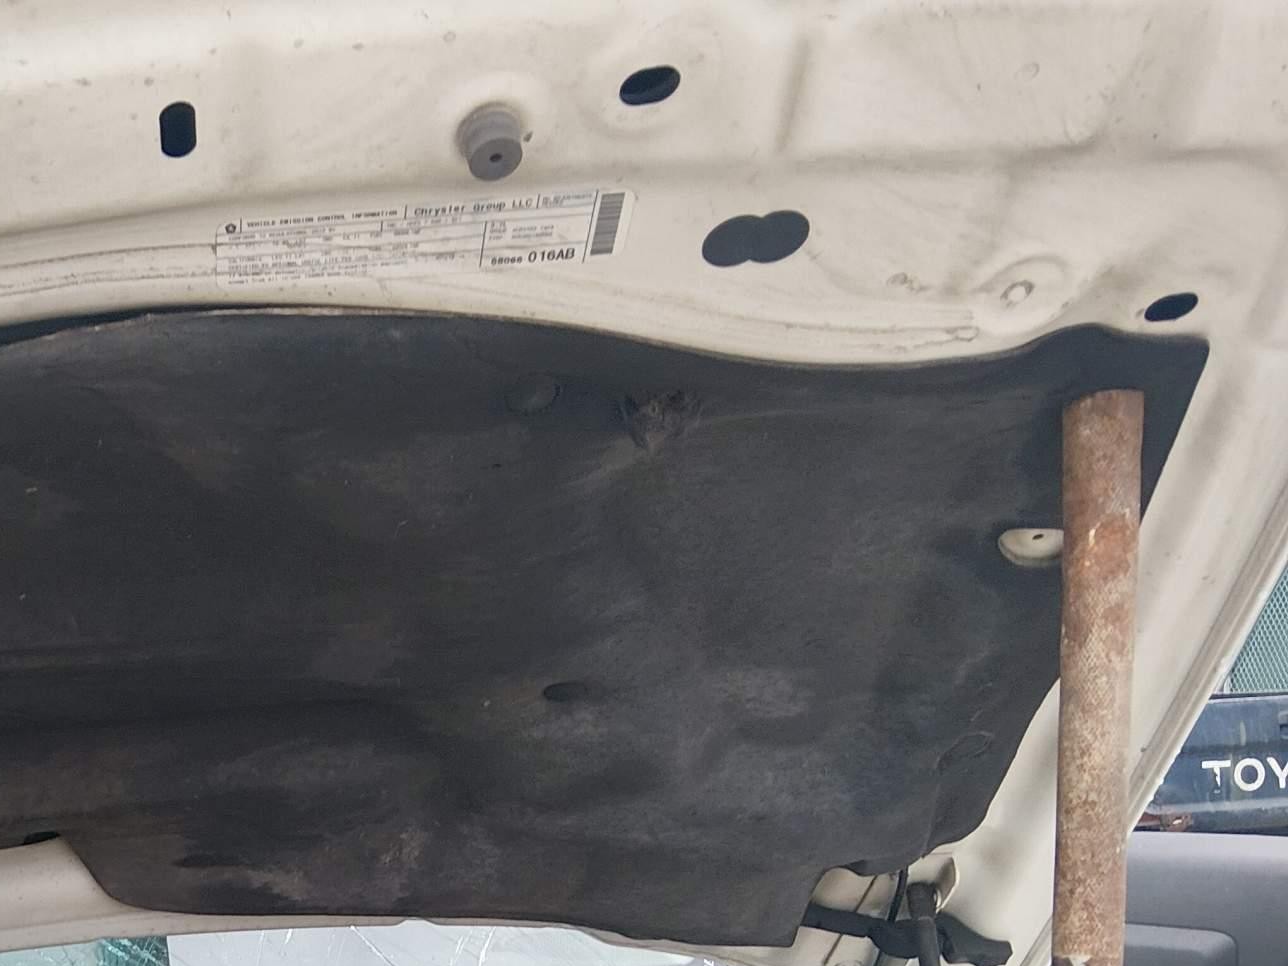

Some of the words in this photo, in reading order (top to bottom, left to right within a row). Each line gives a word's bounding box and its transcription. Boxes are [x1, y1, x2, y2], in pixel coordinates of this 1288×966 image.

[414, 205, 465, 217] Chrysler
[473, 202, 506, 214] Group
[512, 199, 532, 209] LLC
[528, 248, 576, 263] 016AB
[1202, 757, 1288, 792] TOY
